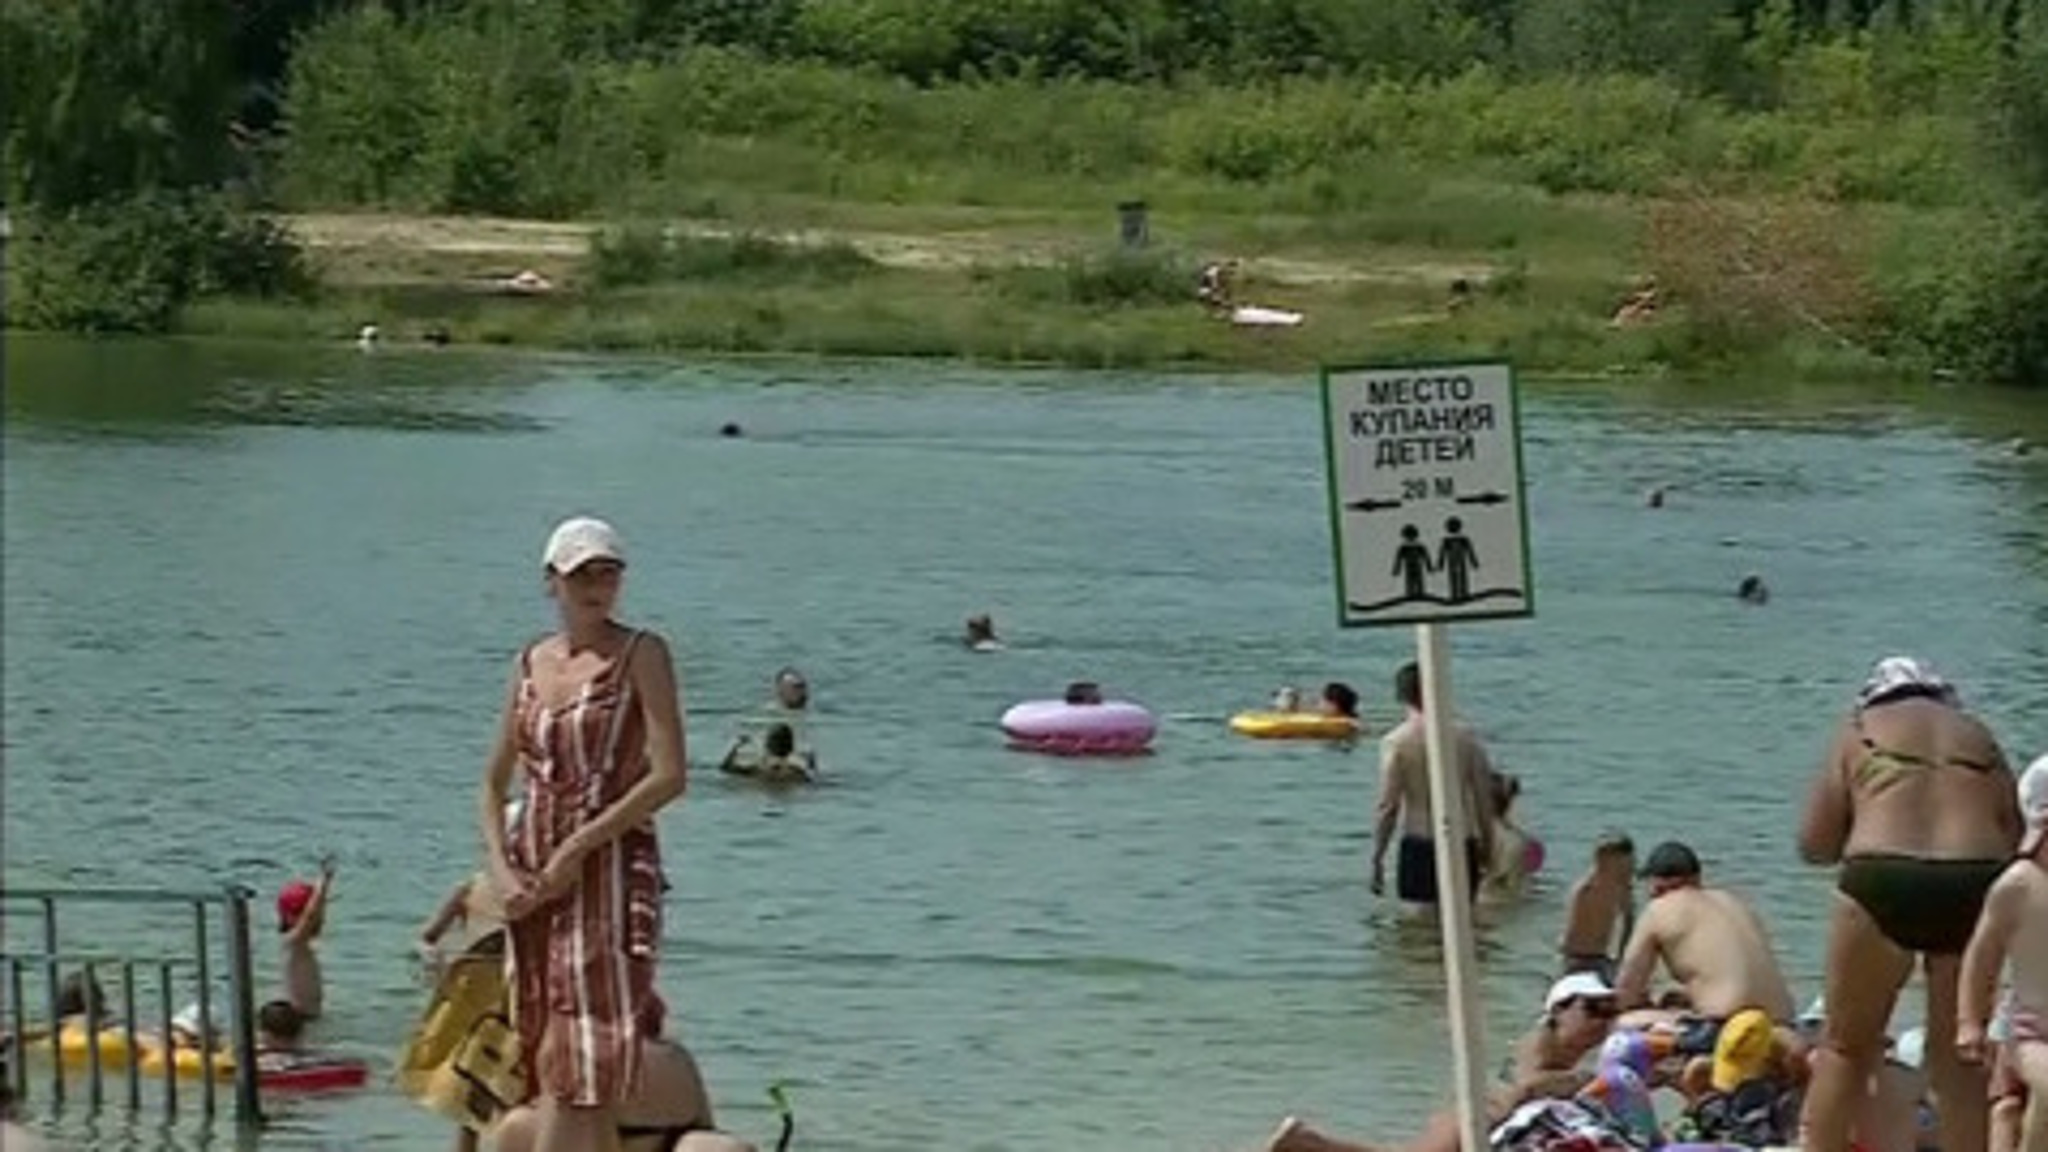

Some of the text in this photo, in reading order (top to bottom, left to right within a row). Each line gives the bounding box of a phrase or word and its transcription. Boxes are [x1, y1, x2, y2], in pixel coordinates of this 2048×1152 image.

[1368, 375, 1473, 404] МЕСТО
[1351, 404, 1494, 437] КУПАНИЯ
[1375, 434, 1475, 469] ДЕТЕЙ
[1402, 479, 1427, 500] 20
